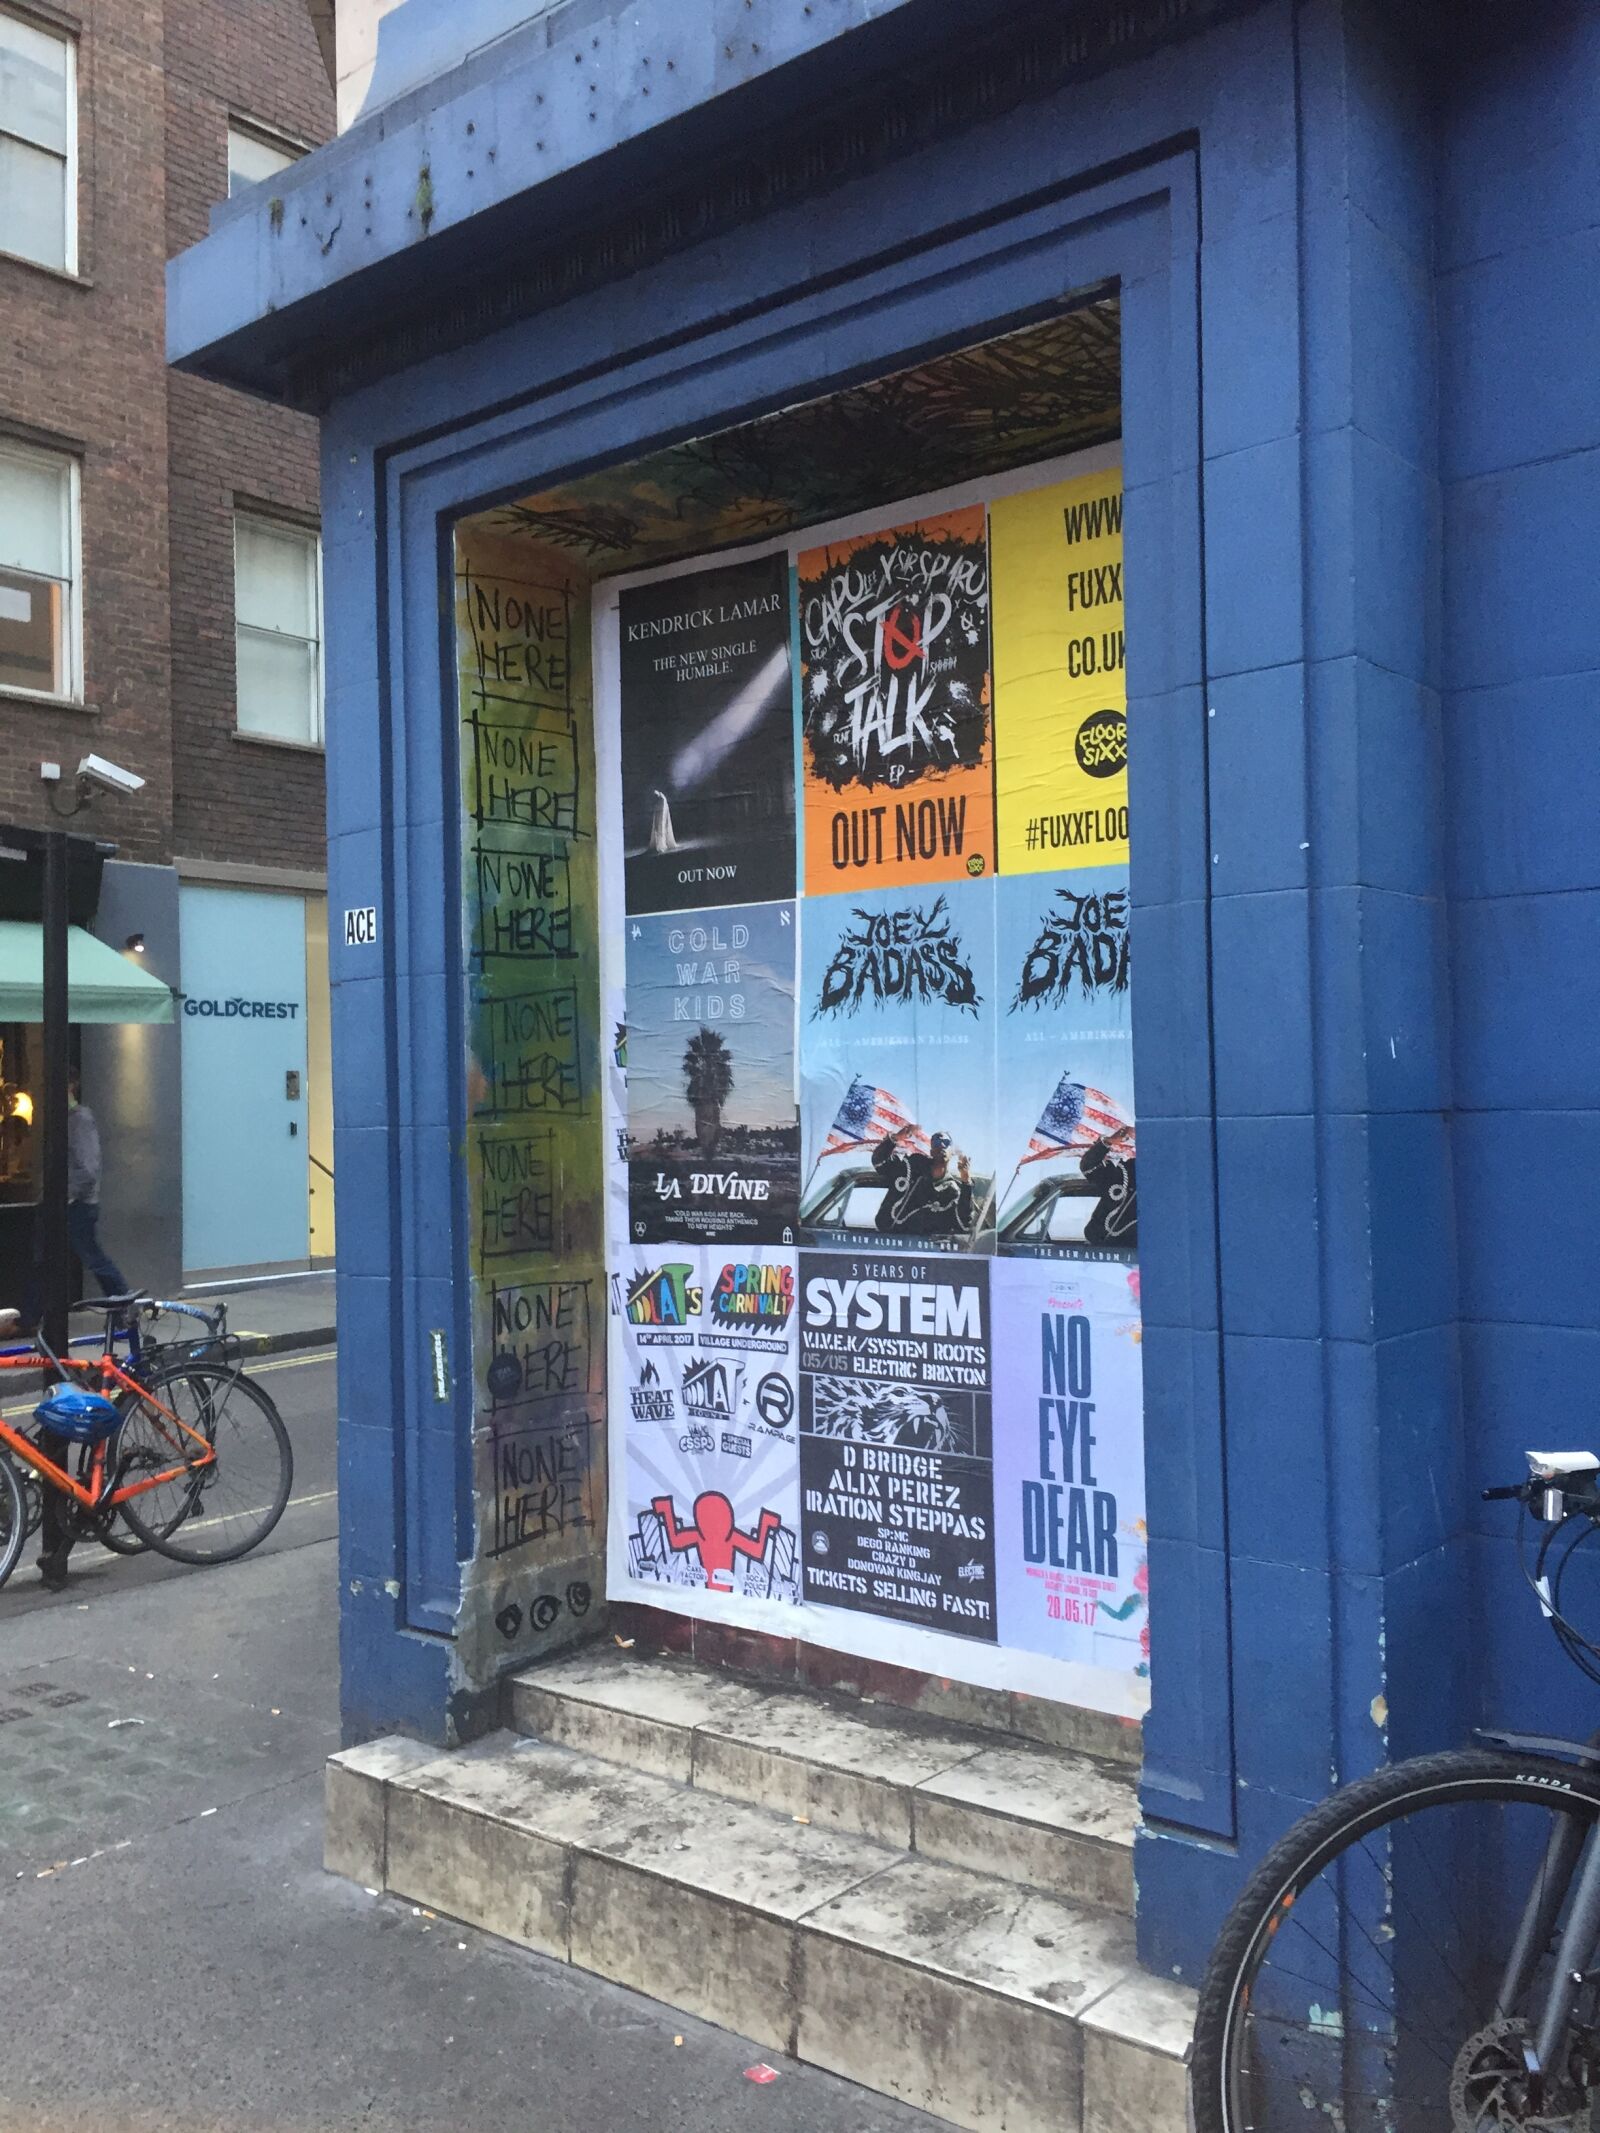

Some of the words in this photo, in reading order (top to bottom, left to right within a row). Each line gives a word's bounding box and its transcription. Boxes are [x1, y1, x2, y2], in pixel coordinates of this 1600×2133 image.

[1068, 562, 1122, 611] FUXX
[475, 584, 565, 642] NONE
[628, 608, 714, 642] KENDRICK
[719, 593, 782, 623] LAMAR
[480, 641, 565, 690] HERE
[653, 655, 676, 672] THE
[679, 649, 710, 668] NEW
[711, 640, 757, 661] SINGLE
[676, 661, 733, 682] HUMBLE.
[844, 672, 940, 773] TALK
[1079, 722, 1126, 750] FLOOR
[484, 728, 557, 777] NONE
[489, 774, 575, 829] HERE
[832, 806, 886, 870] OUT
[896, 795, 966, 862] NOW
[678, 868, 703, 884] OUT
[706, 865, 737, 881] NOW
[346, 908, 375, 944] ACE
[494, 906, 570, 951] HERE
[848, 893, 950, 947] JOEY
[668, 924, 750, 954] COLD
[676, 960, 741, 986] WAR
[184, 999, 299, 1019] GOLDCREST
[504, 996, 572, 1043] NONE
[673, 994, 746, 1021] KIDS
[502, 1052, 580, 1108] HERE
[481, 1138, 544, 1182] NONE
[655, 1172, 682, 1200] LA
[689, 1171, 770, 1200] DIVINE
[485, 1187, 551, 1243] HERE
[720, 1263, 794, 1296] SPRING
[852, 1263, 858, 1277] 5
[864, 1264, 904, 1278] YEARS
[911, 1266, 927, 1279] OF
[497, 1287, 578, 1335] NONE
[806, 1277, 982, 1340] SYSTEM
[652, 1334, 674, 1345] APRIL
[674, 1334, 692, 1345] 2017
[699, 1335, 731, 1347] VILLAGE
[731, 1338, 787, 1352] UNDERGROUND
[933, 1342, 986, 1365] ROOTS
[1041, 1312, 1091, 1399] NO
[802, 1351, 848, 1371] 05/05
[853, 1356, 918, 1379] ELECTRIC
[922, 1363, 987, 1386] BRIXTON
[630, 1389, 674, 1405] HEAT
[631, 1404, 675, 1420] WAVE
[722, 1441, 751, 1456] GUESTS
[748, 1422, 796, 1444] RAMPAGE
[1038, 1397, 1098, 1486] EYE
[504, 1430, 583, 1488] NONE
[843, 1445, 856, 1467] D
[863, 1448, 943, 1480] BRIDGE
[829, 1469, 881, 1497] ALIX
[888, 1477, 961, 1510] PEREZ
[806, 1489, 883, 1524] IRATION
[888, 1503, 986, 1540] STEPPAS
[1022, 1479, 1119, 1578] DEAR
[877, 1527, 909, 1543] SP:MC
[885, 1540, 931, 1559] RANKING
[847, 1557, 895, 1578] DONOVAN
[871, 1550, 906, 1568] CRAZY
[908, 1556, 916, 1568] D
[807, 1566, 868, 1595] TICKETS
[873, 1579, 937, 1609] SELLING
[942, 1593, 991, 1620] FAST!
[1046, 1594, 1097, 1626] 20.05.17
[1515, 1774, 1571, 1790] KENDA
